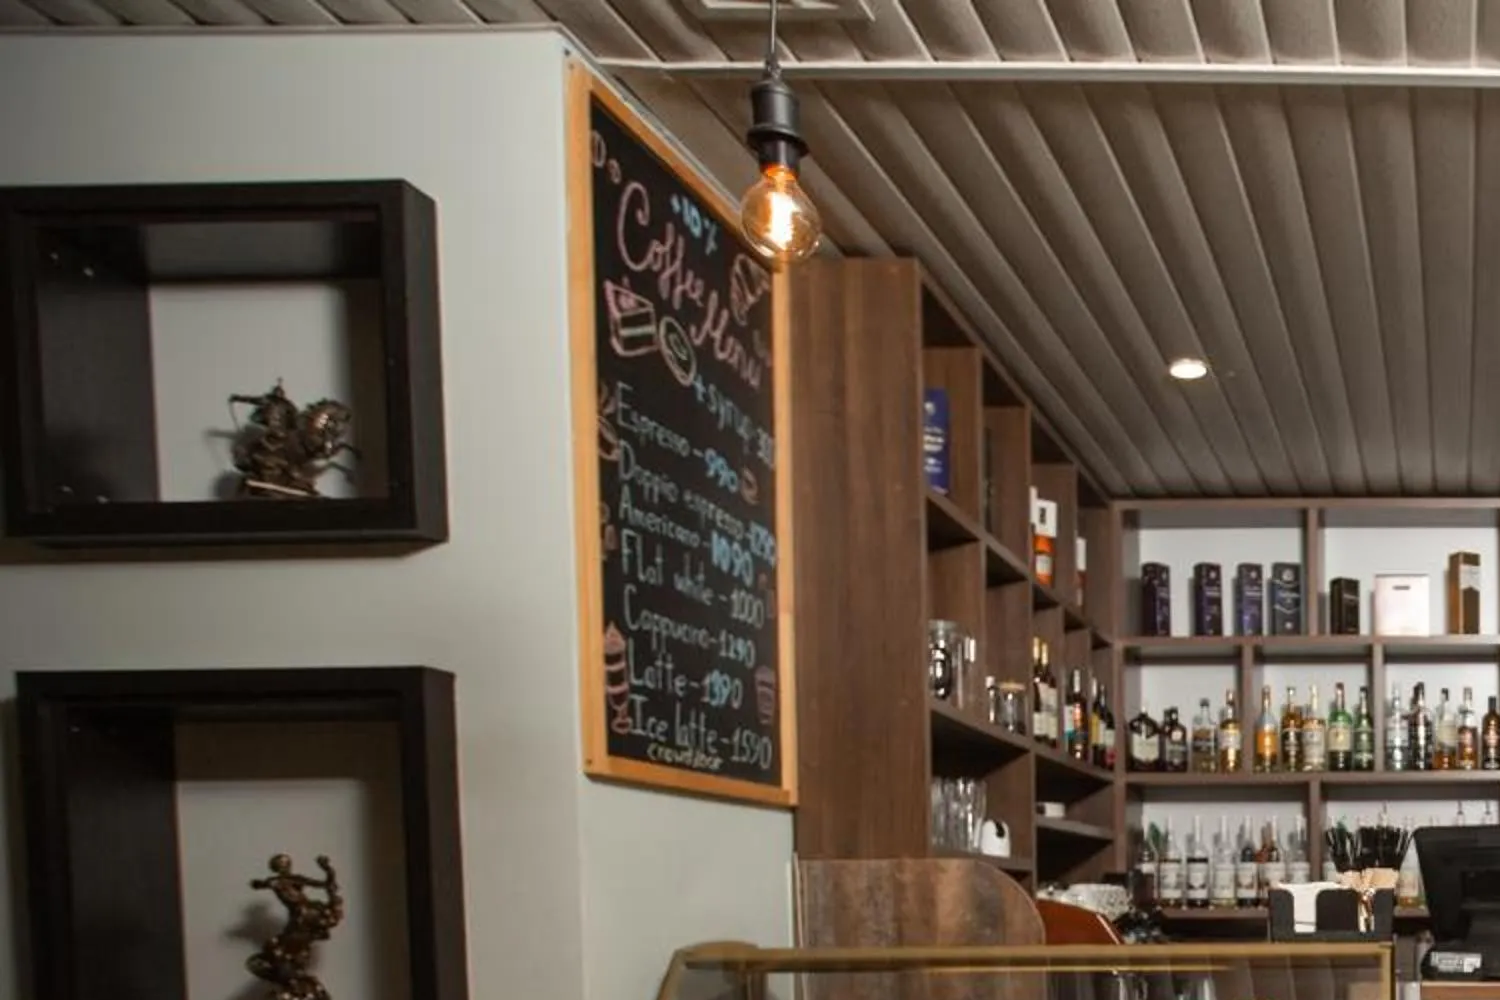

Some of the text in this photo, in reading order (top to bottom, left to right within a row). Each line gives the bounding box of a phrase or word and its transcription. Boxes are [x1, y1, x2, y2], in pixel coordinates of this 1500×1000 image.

[616, 181, 762, 388] Coffee Menu
[621, 527, 663, 587] Flat
[628, 636, 688, 698] Latte
[628, 690, 669, 742] Ice
[674, 699, 718, 756] latte
